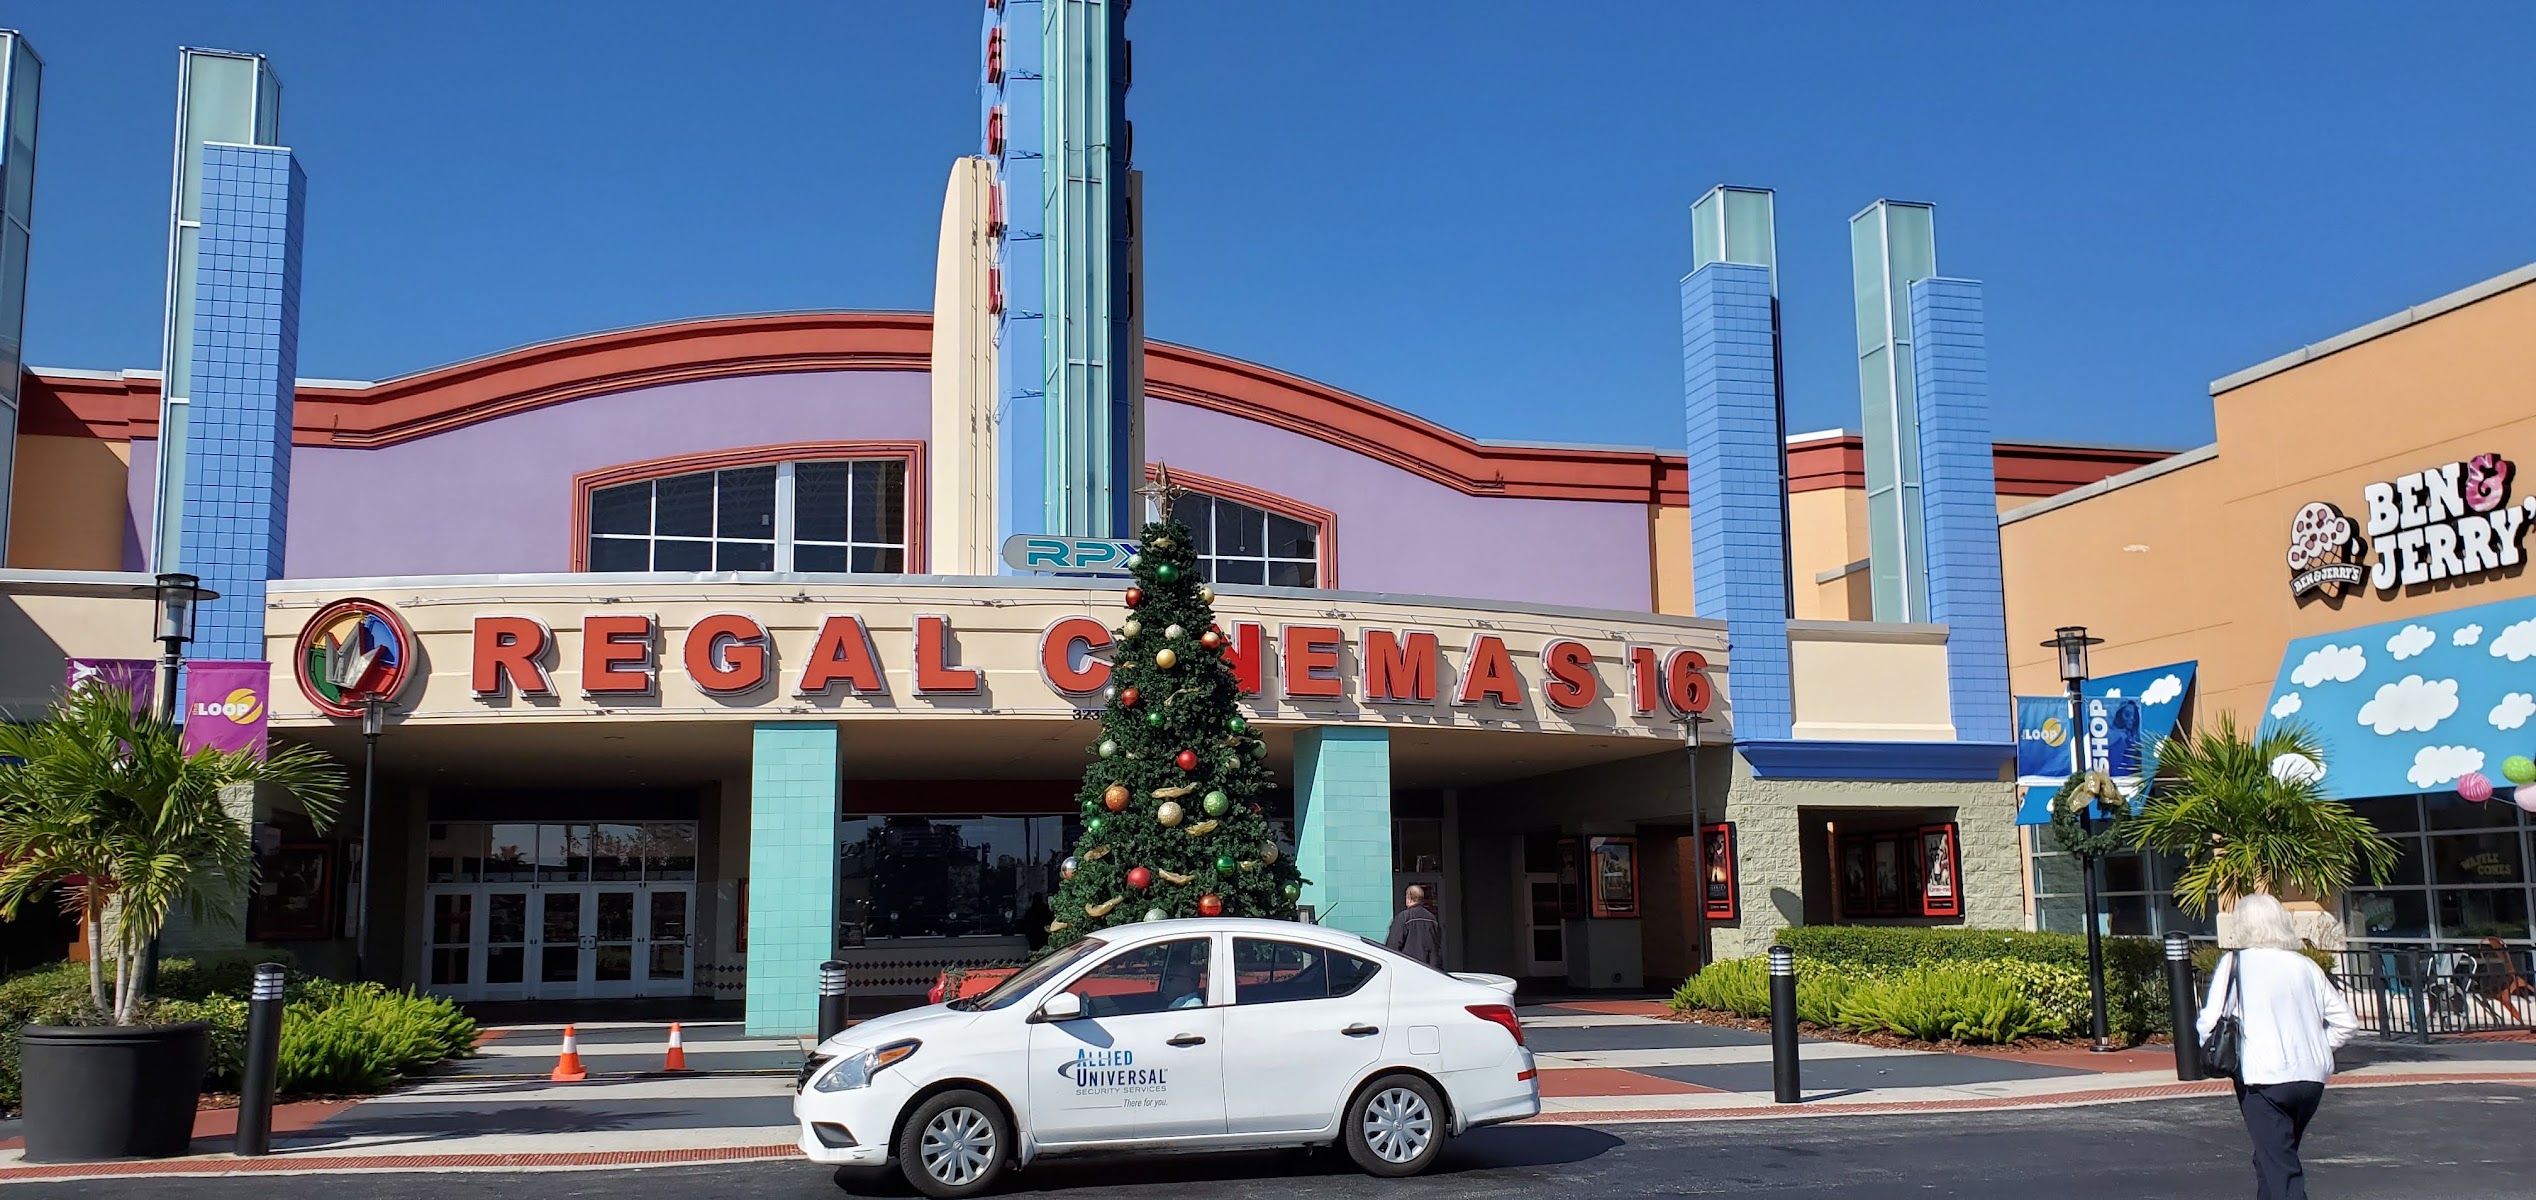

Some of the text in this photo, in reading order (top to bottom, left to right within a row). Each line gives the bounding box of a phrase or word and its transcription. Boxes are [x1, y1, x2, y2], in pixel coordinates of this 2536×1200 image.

[987, 0, 1006, 315] EGAL
[471, 610, 1712, 720] REGAL CNEMAS 16
[198, 702, 249, 716] LOOP
[2026, 729, 2058, 741] LOOP
[2089, 699, 2110, 773] SHOP
[1077, 1048, 1133, 1067] ALLIED
[1077, 1068, 1167, 1087] UNIVERSAL
[1076, 1085, 1167, 1095] SECURITY SERVICES
[1123, 1097, 1168, 1108] There for you.
